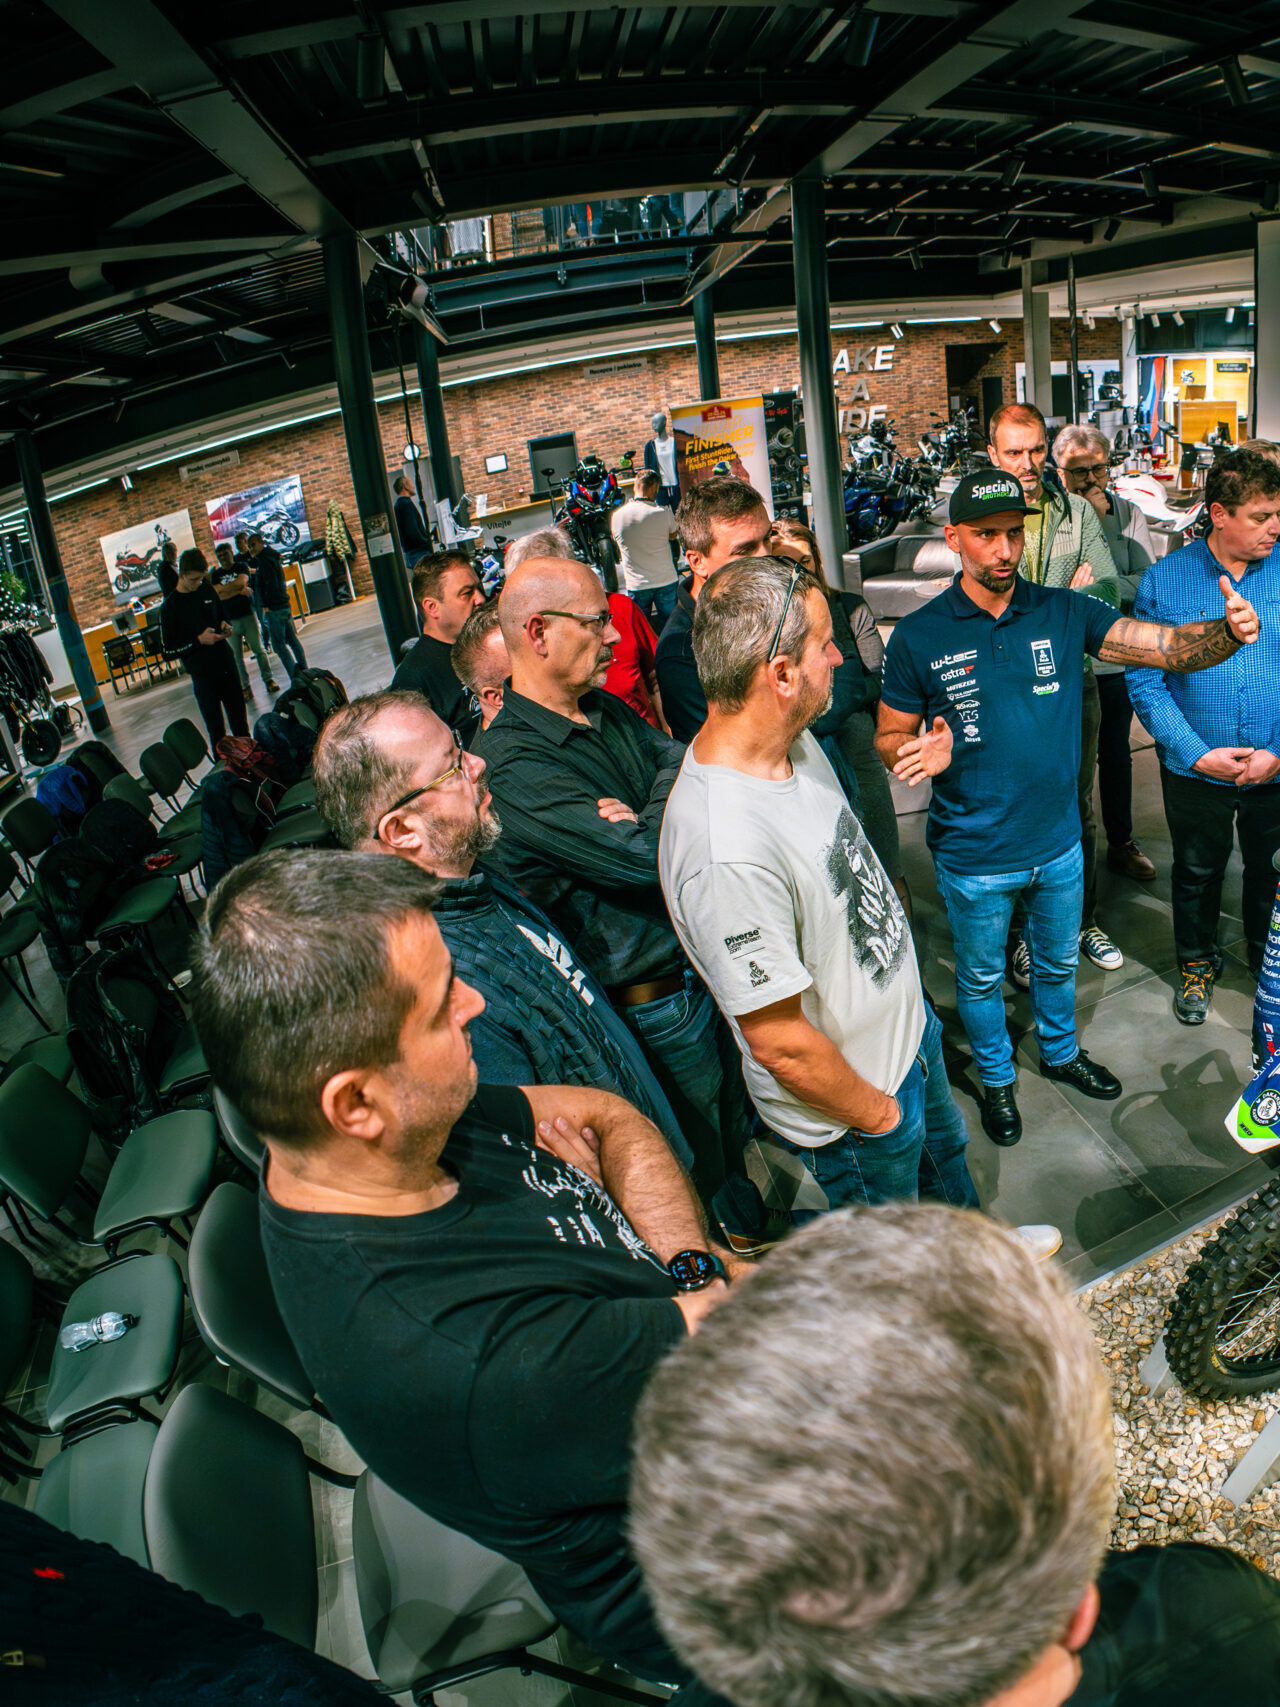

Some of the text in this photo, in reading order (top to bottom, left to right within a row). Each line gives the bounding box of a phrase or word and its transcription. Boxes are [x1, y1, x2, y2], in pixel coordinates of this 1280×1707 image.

[832, 345, 895, 375] AKE
[850, 378, 871, 403] A
[839, 404, 888, 434] IDE
[685, 425, 754, 456] FINISHER
[971, 481, 1010, 499] Special
[931, 649, 978, 670] w-tec
[724, 929, 760, 946] Diverse
